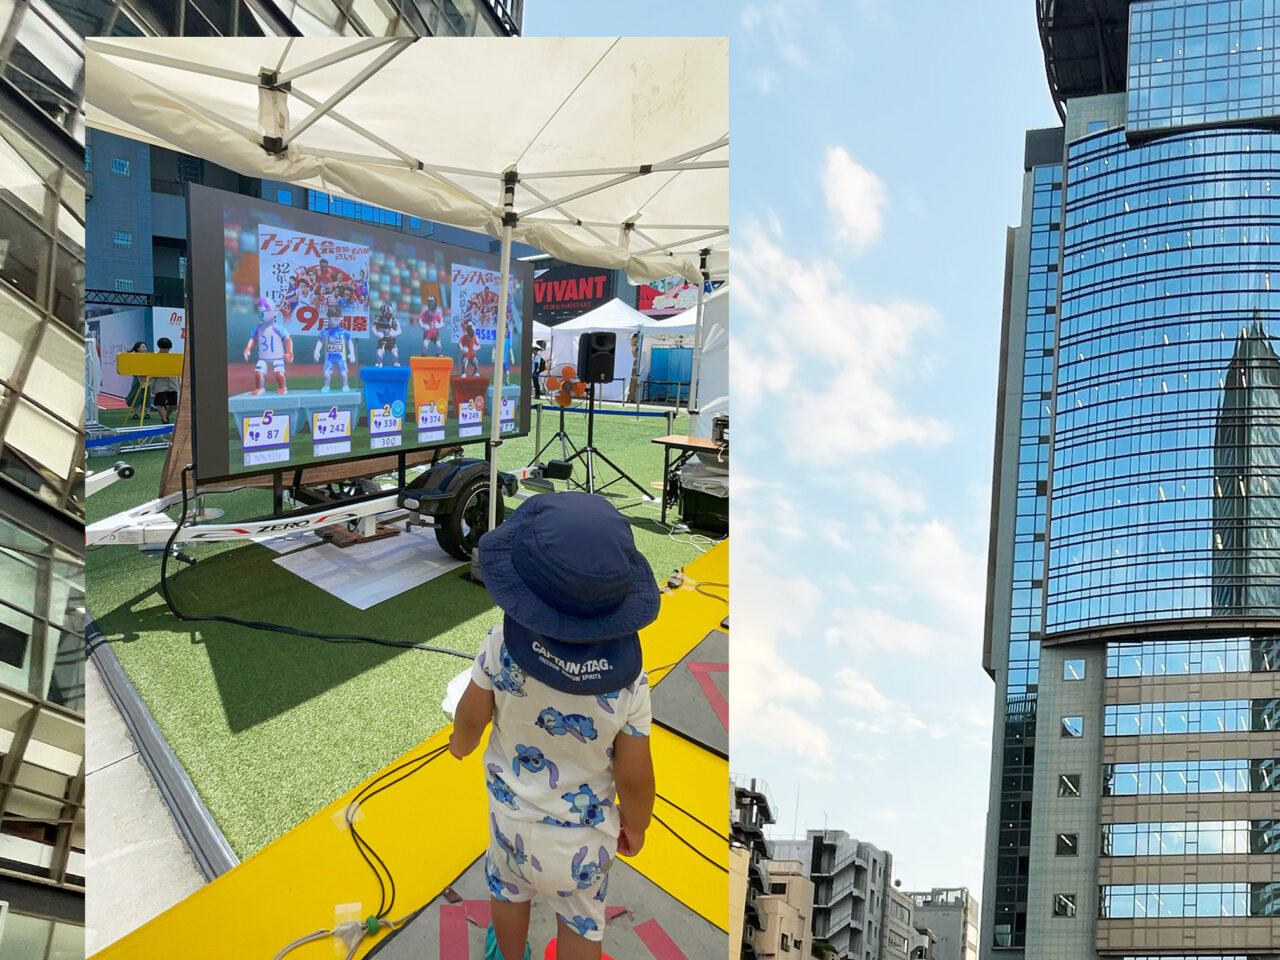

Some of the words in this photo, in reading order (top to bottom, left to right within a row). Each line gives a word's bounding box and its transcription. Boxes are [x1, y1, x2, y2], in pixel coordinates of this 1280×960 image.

[260, 233, 336, 258] アジア大会
[534, 275, 607, 303] VIVANT
[262, 410, 273, 425] 5
[328, 407, 337, 420] 4
[383, 404, 391, 417] 2
[267, 429, 279, 439] 87
[330, 424, 345, 433] 242
[257, 519, 310, 534] ZERO
